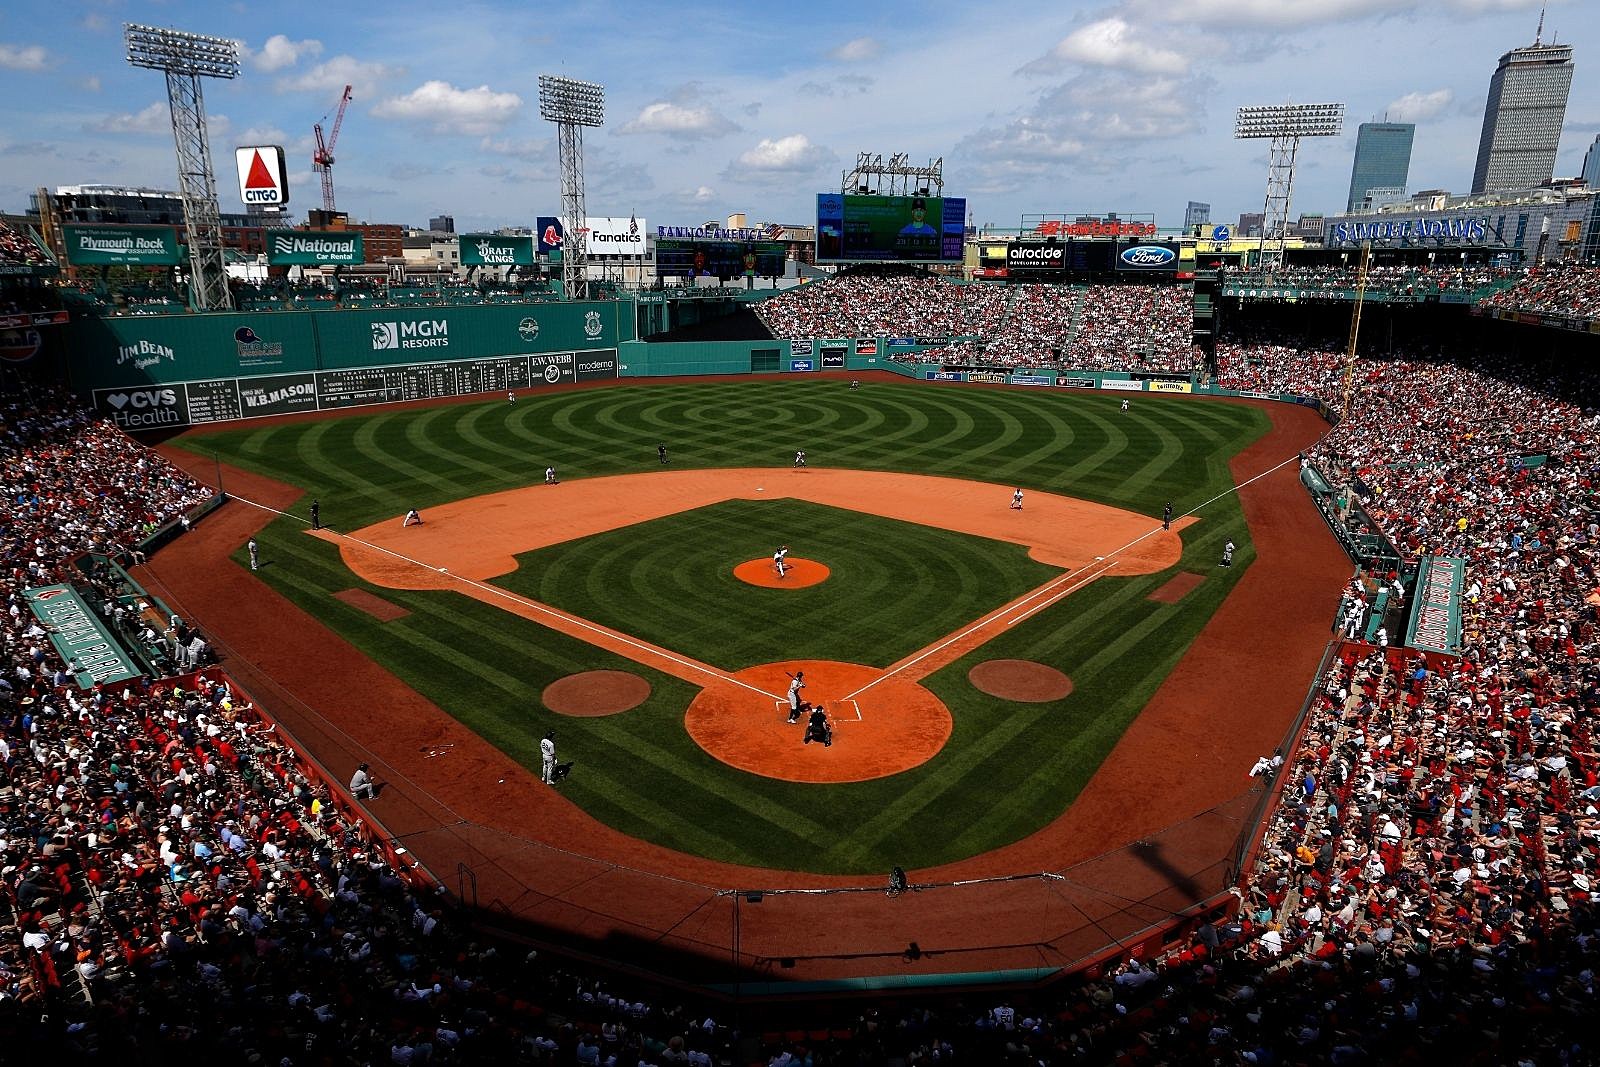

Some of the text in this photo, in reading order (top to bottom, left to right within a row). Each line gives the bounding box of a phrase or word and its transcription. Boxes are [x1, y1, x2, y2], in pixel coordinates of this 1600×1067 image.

[245, 190, 278, 201] CITGO
[592, 230, 641, 242] Fanatics
[1336, 217, 1486, 242] SAMUEL ADAMS
[80, 236, 164, 250] Plymouth Rock
[478, 246, 514, 256] DRAFT
[1010, 246, 1062, 258] airocide
[1131, 248, 1164, 264] Ford
[484, 255, 515, 263] KINGS
[400, 320, 448, 338] MGM
[402, 338, 449, 349] RESORTS
[116, 340, 175, 365] JIM BEAM
[548, 354, 572, 364] WEBB
[579, 360, 613, 370] moderna
[130, 389, 177, 408] CVS
[112, 407, 180, 427] Health
[43, 600, 129, 682] FENWAY PARK
